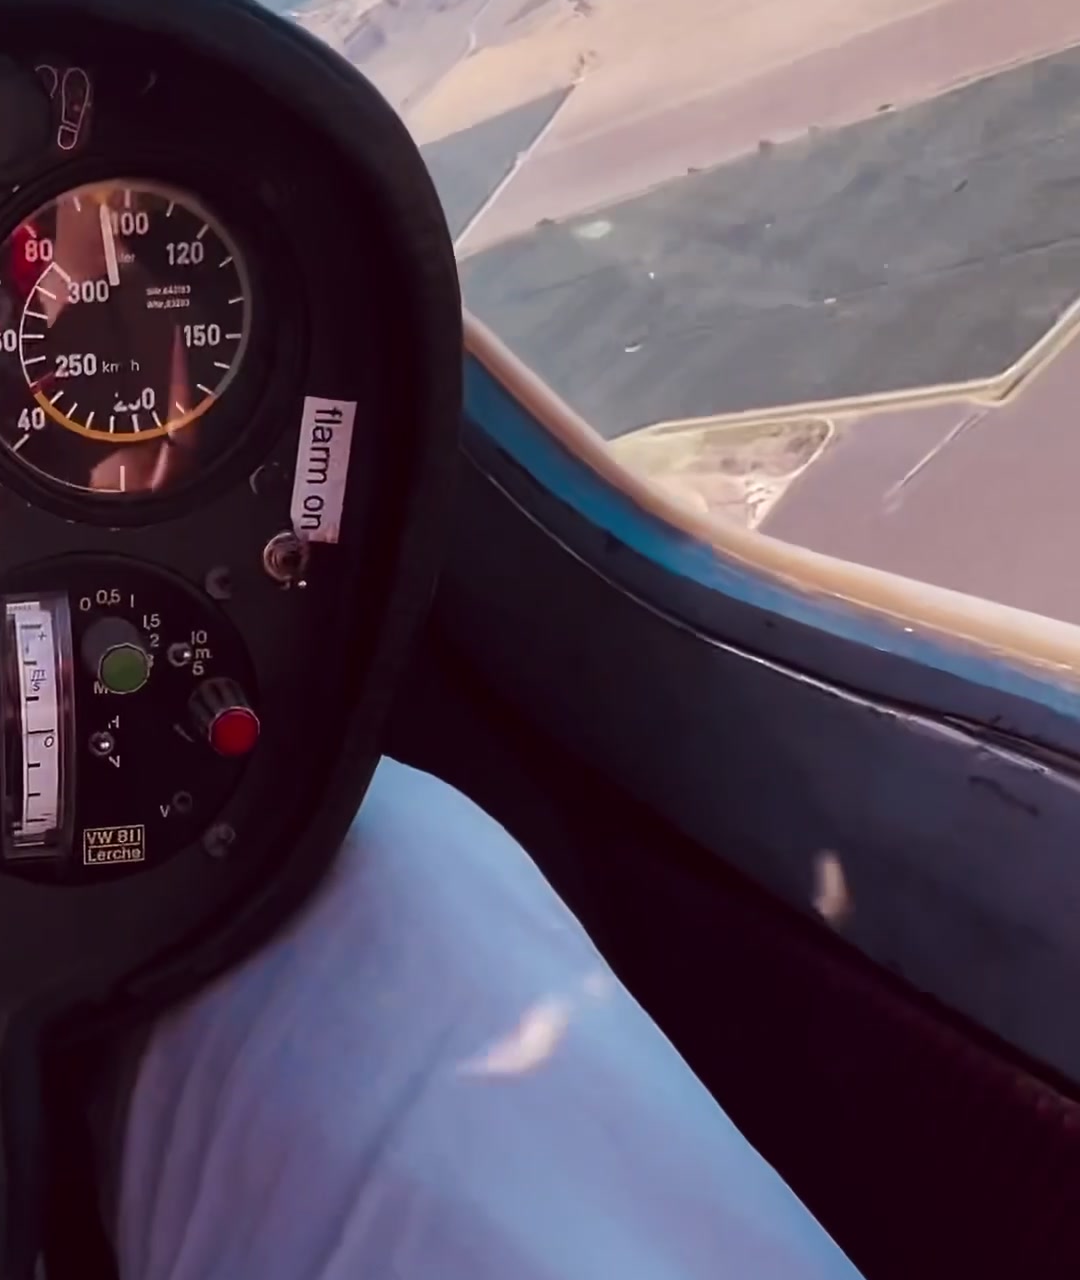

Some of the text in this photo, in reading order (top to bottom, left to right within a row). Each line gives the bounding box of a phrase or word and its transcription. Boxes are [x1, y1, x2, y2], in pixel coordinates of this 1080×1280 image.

[111, 212, 149, 235] 100
[25, 239, 53, 262] 80
[166, 242, 204, 265] 120
[69, 280, 109, 303] 300
[184, 325, 221, 347] 150
[55, 353, 97, 377] 250
[18, 408, 46, 431] 40
[300, 406, 343, 530] flarm on
[80, 597, 91, 611] 0
[150, 634, 159, 647] 2
[160, 805, 170, 818] V
[86, 830, 114, 845] VW
[88, 847, 141, 862] Lerche
